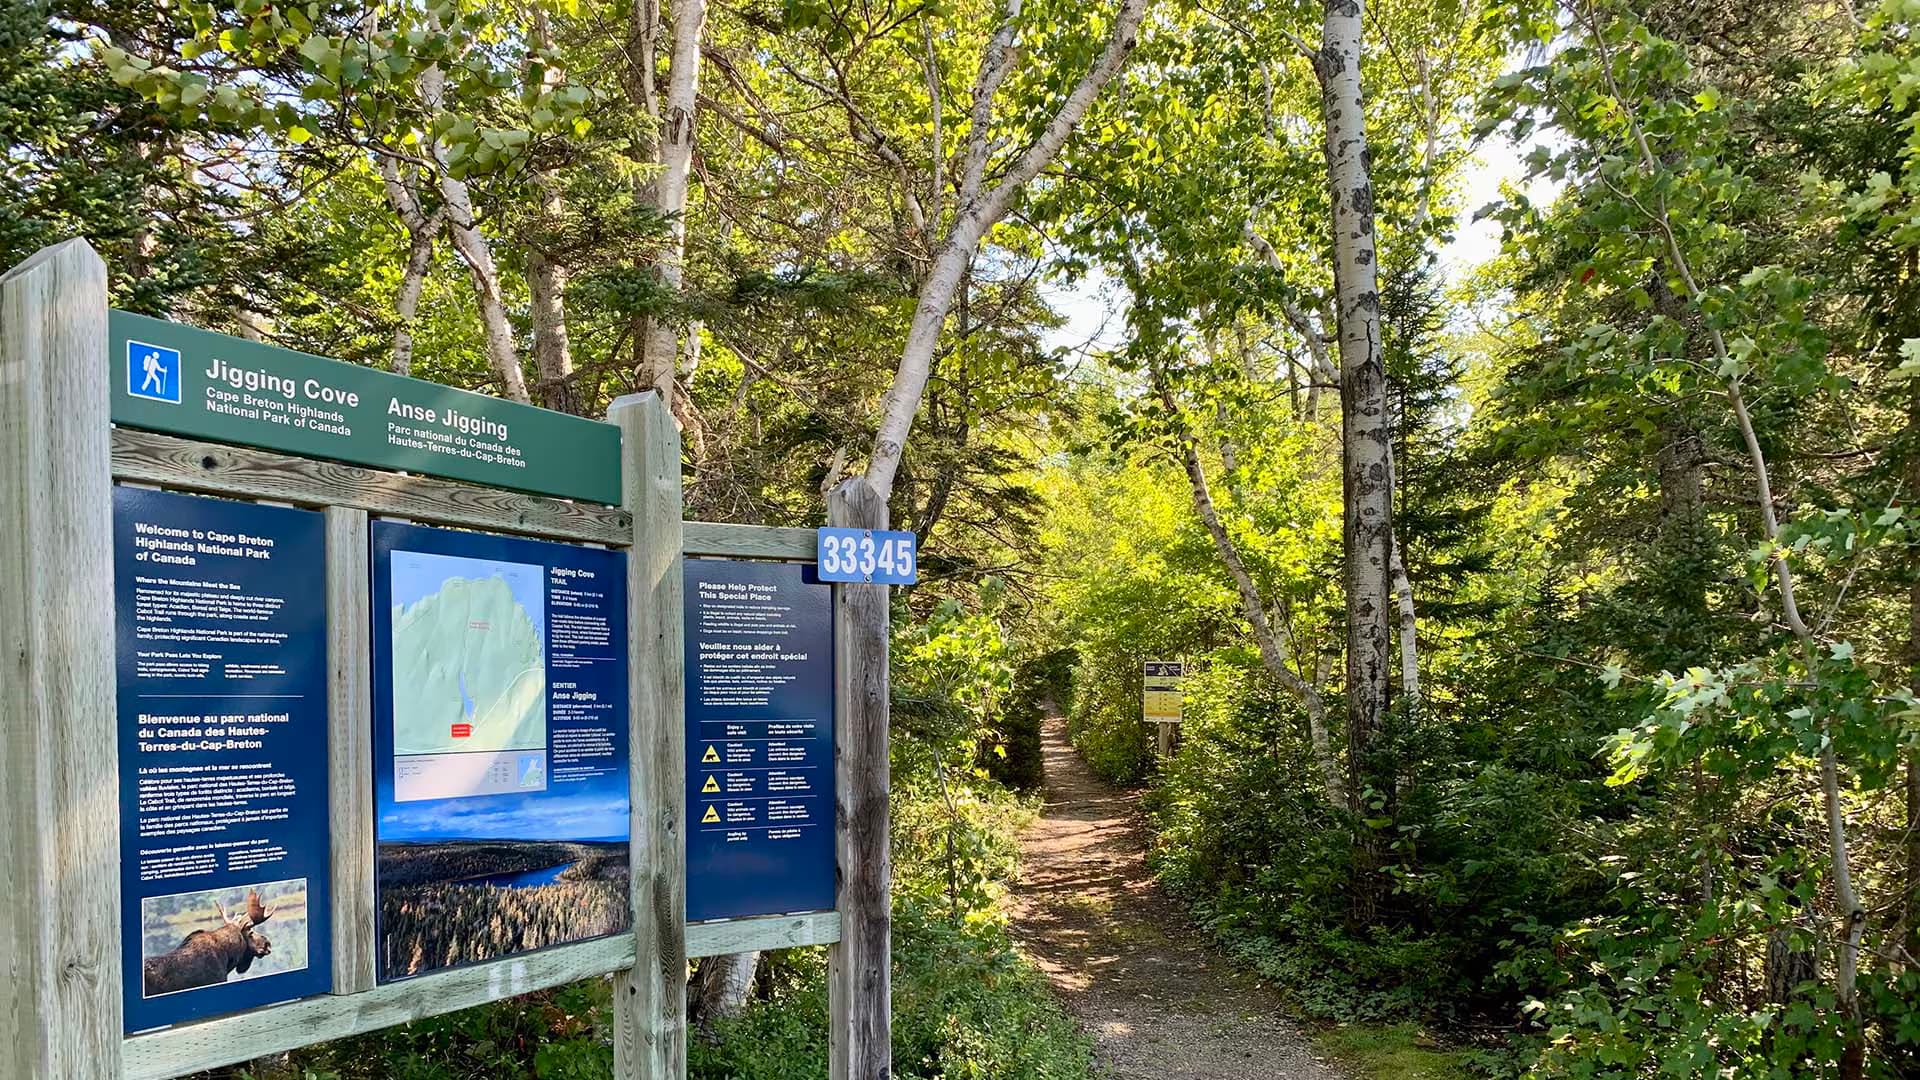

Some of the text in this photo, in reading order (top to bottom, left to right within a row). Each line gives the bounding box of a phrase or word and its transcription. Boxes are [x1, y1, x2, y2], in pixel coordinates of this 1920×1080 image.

[206, 358, 359, 408] Jigging Cove
[206, 386, 344, 424] Cape Breton Highlands
[206, 400, 351, 436] National Park of Canada
[388, 397, 509, 441] Anse Jigging
[388, 422, 521, 457] Parc national du Canada des
[388, 433, 526, 469] Hautes-Terres-du-Cap-Breton
[135, 523, 274, 547] Welcome to Cape Breton
[136, 537, 270, 560] Highlands National Park
[136, 552, 196, 566] of Canada
[823, 535, 913, 577] 33345
[551, 567, 594, 578] Jigging Cove
[699, 582, 777, 592] Please Help Protect
[699, 591, 717, 599] This
[719, 592, 748, 600] Special
[754, 643, 774, 651] aider
[699, 652, 734, 661] protéger
[780, 653, 808, 661] spécial
[552, 691, 597, 701] Anse Jigging
[139, 713, 289, 725] Bienvenue au parc national
[139, 726, 270, 739] du Canada des Hautes-
[139, 740, 263, 752] Terres-du-Cap-Breton
